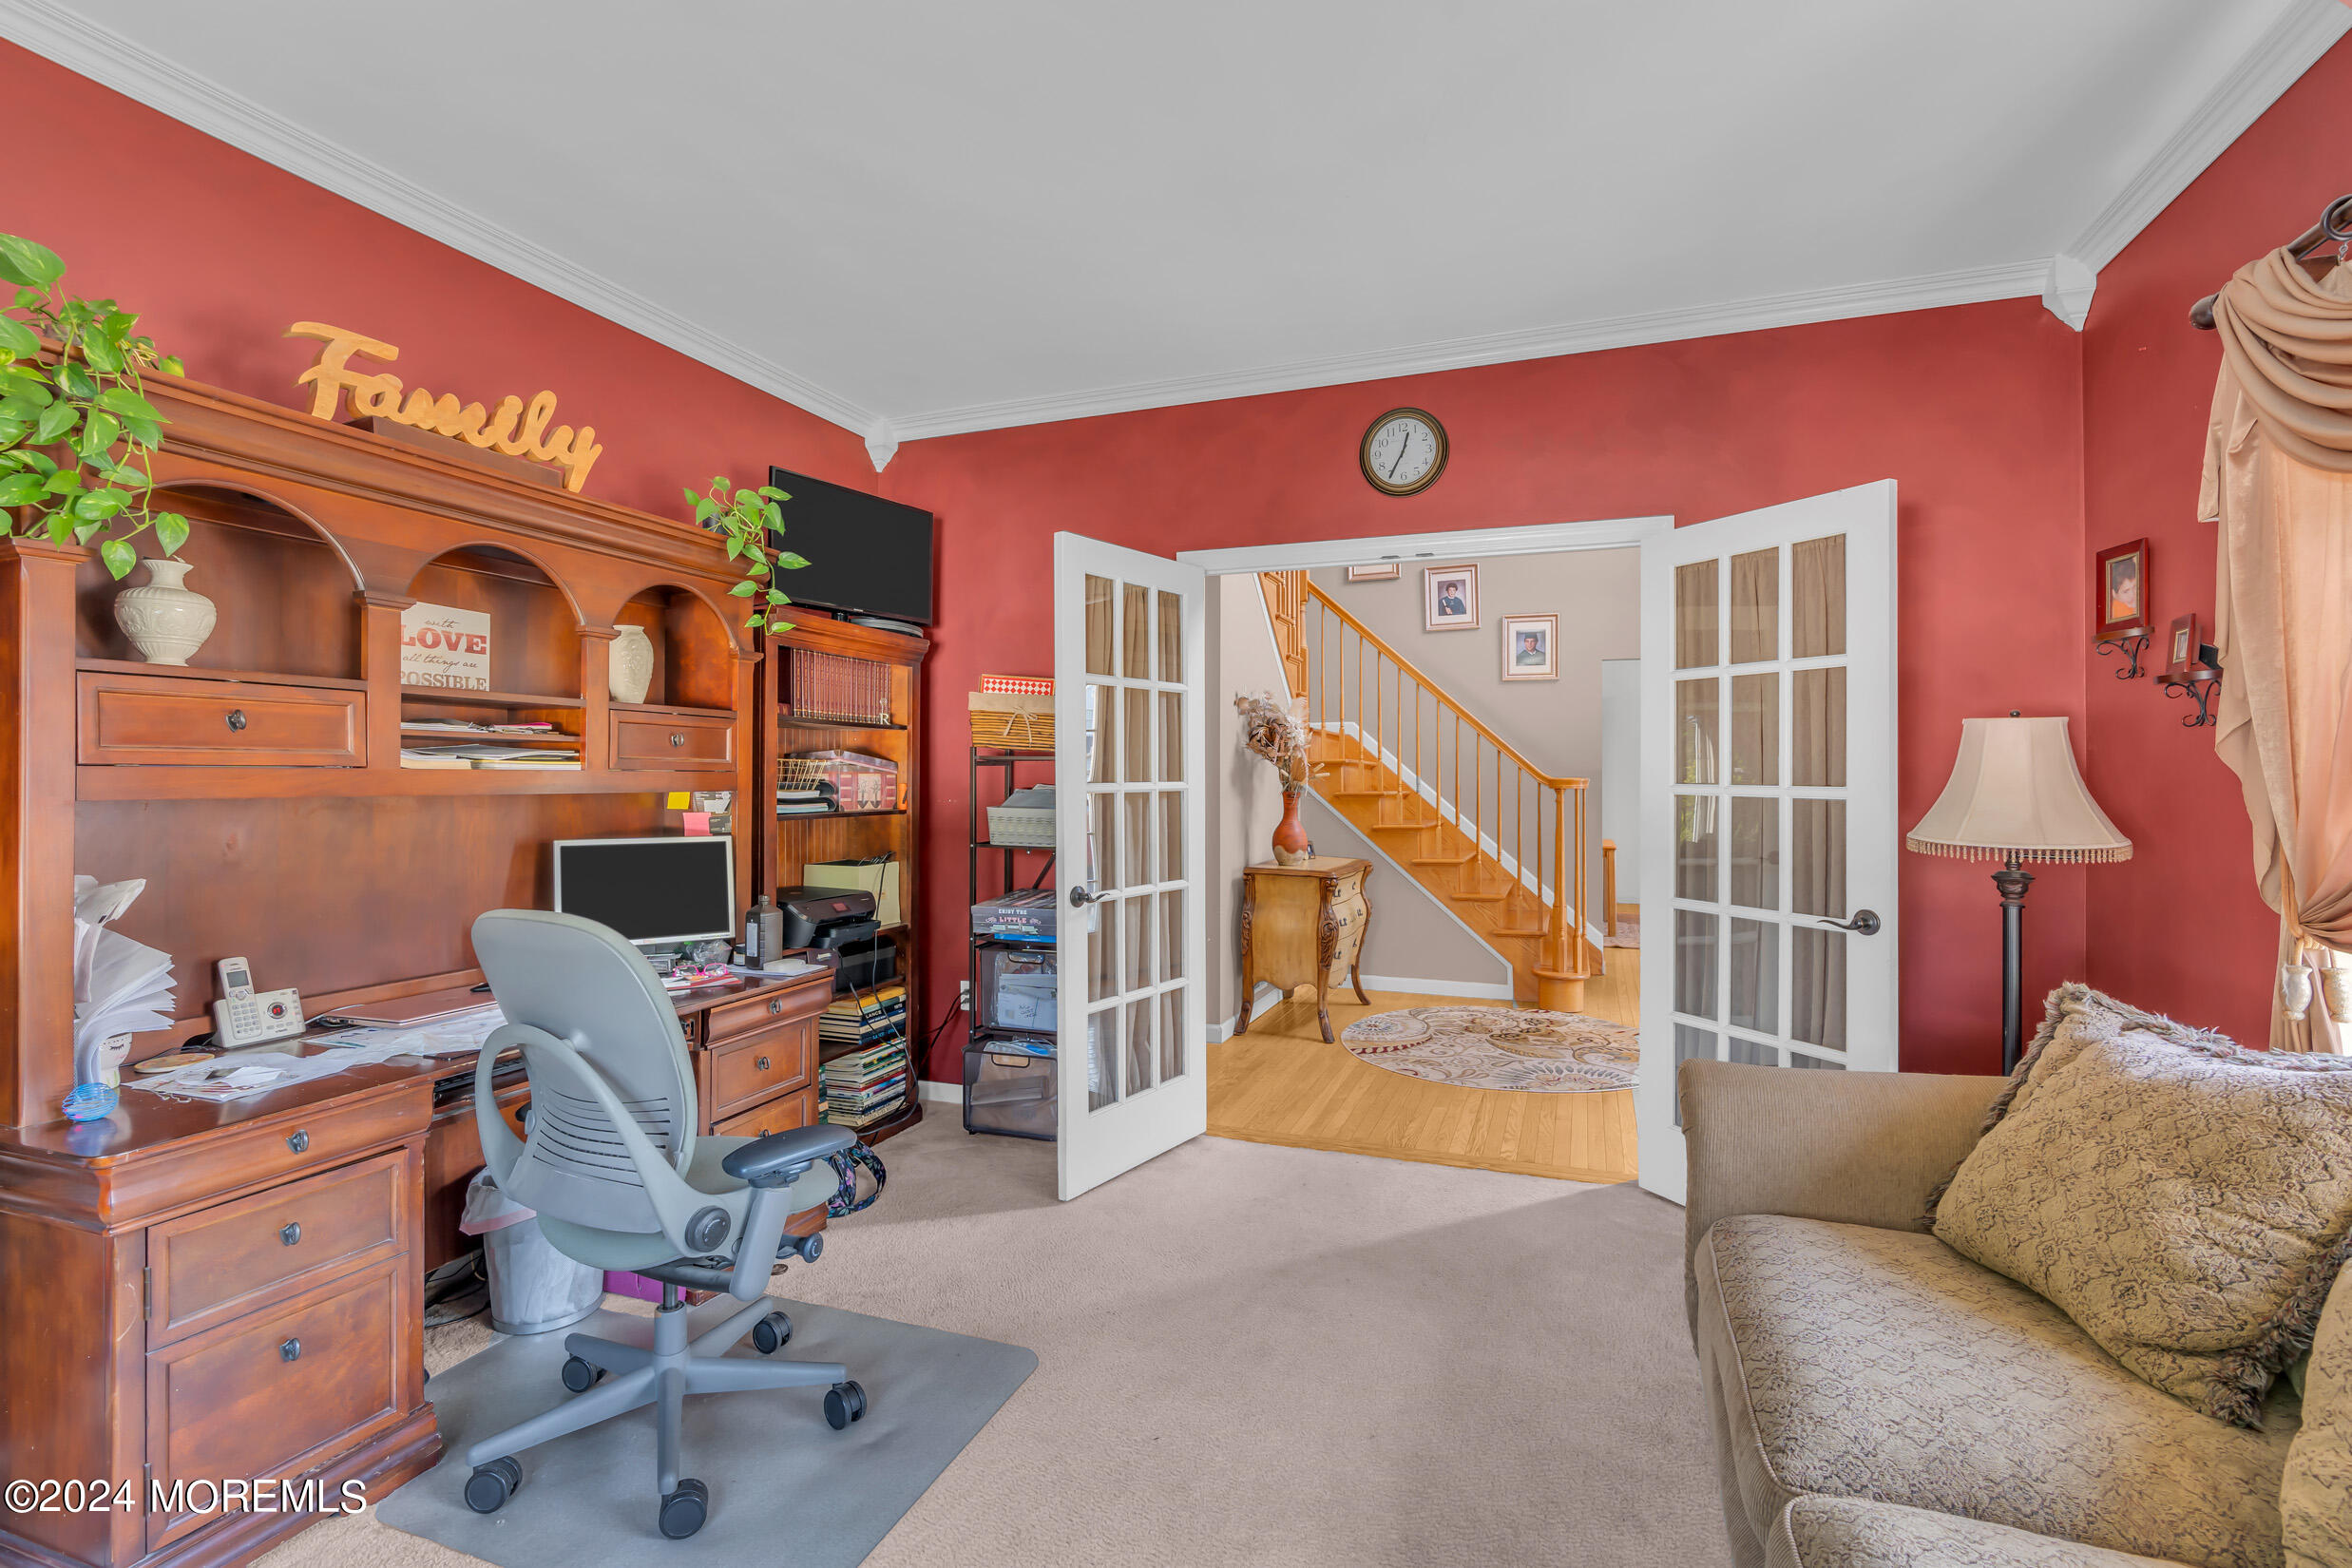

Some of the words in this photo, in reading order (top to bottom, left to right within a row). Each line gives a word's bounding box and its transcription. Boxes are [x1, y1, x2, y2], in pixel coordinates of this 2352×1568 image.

[282, 321, 603, 493] Family
[1398, 422, 1408, 432] 12
[1386, 428, 1395, 437] 11
[1422, 431, 1428, 441] 2
[1378, 439, 1388, 448] 10
[1425, 444, 1432, 453] 3
[1374, 450, 1382, 459] 9
[1378, 462, 1386, 470] 8
[1422, 457, 1428, 466] 4
[1400, 471, 1406, 481] 6
[1413, 467, 1421, 475] 5
[425, 618, 460, 629] with
[401, 624, 487, 655] LOVE
[403, 653, 422, 662] all
[423, 654, 460, 673] things
[879, 713, 890, 725] R
